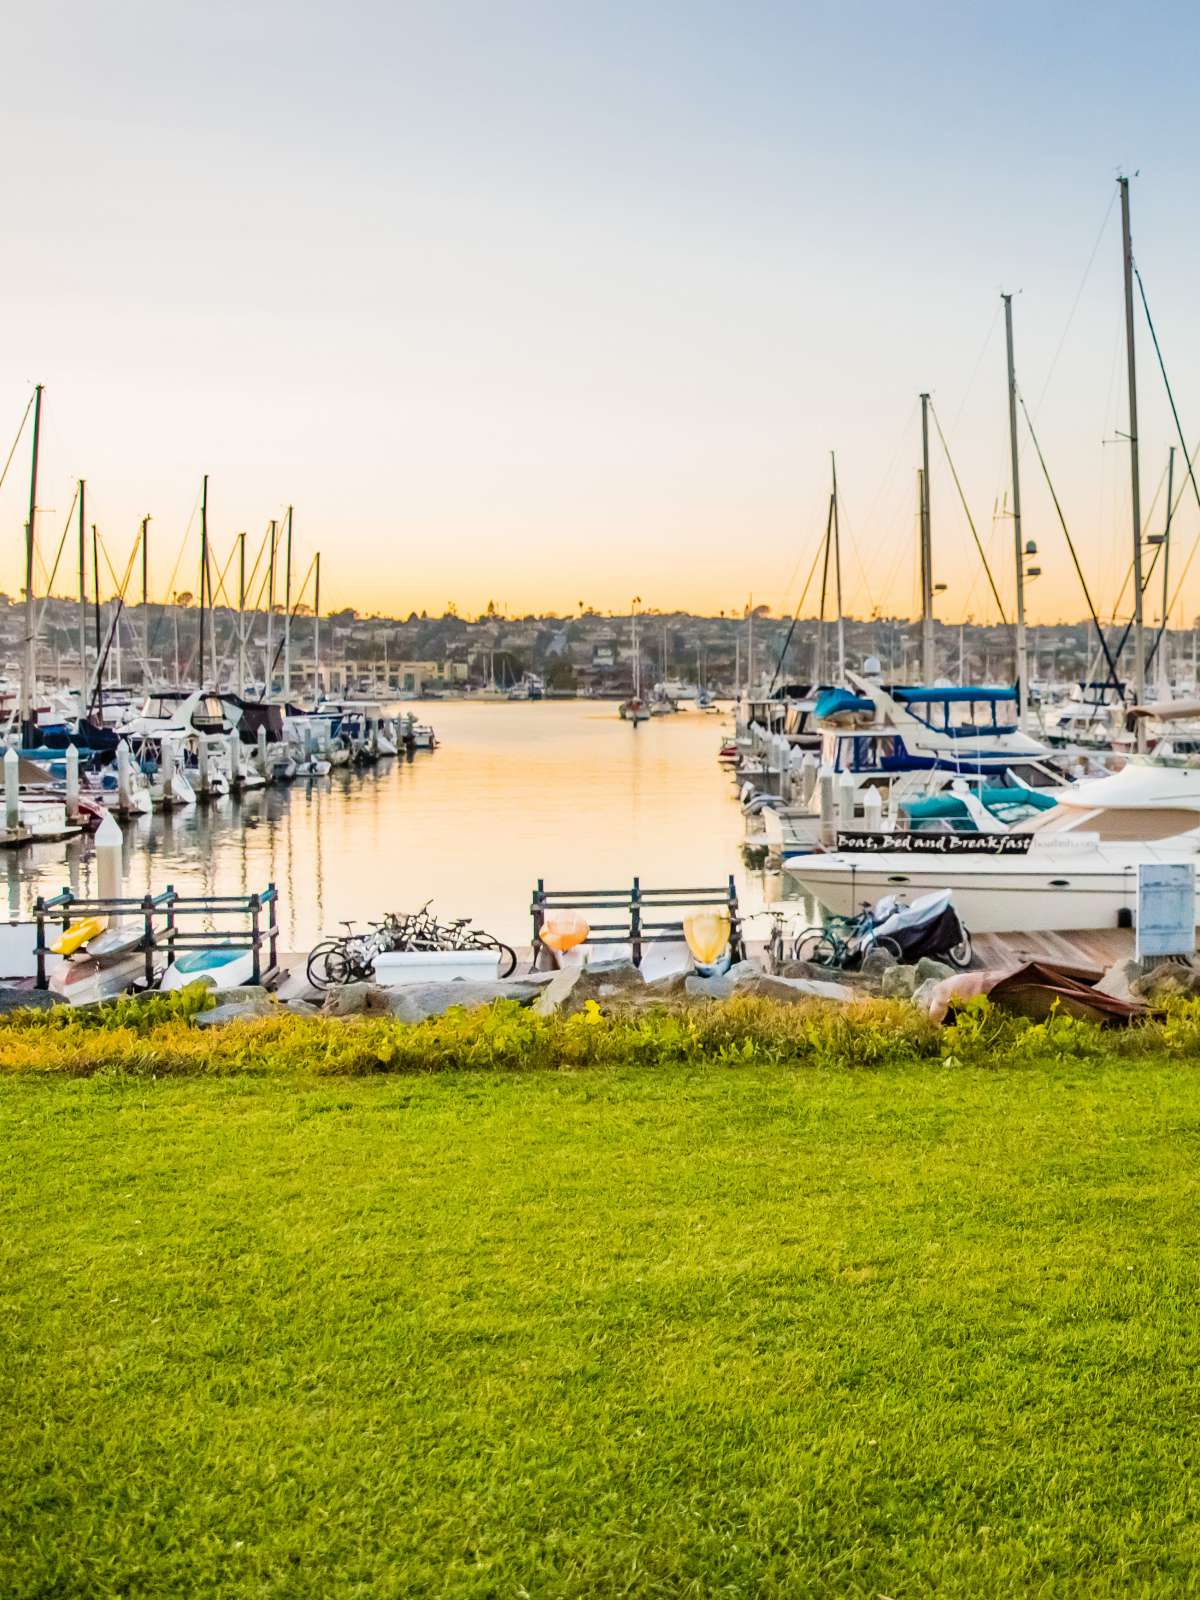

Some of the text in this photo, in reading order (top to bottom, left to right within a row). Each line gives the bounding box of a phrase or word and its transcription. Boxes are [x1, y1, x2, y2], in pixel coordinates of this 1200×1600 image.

[837, 834, 878, 849] Boat,
[882, 834, 912, 851] Bed
[914, 836, 946, 852] and
[949, 835, 1031, 854] Breakfast
